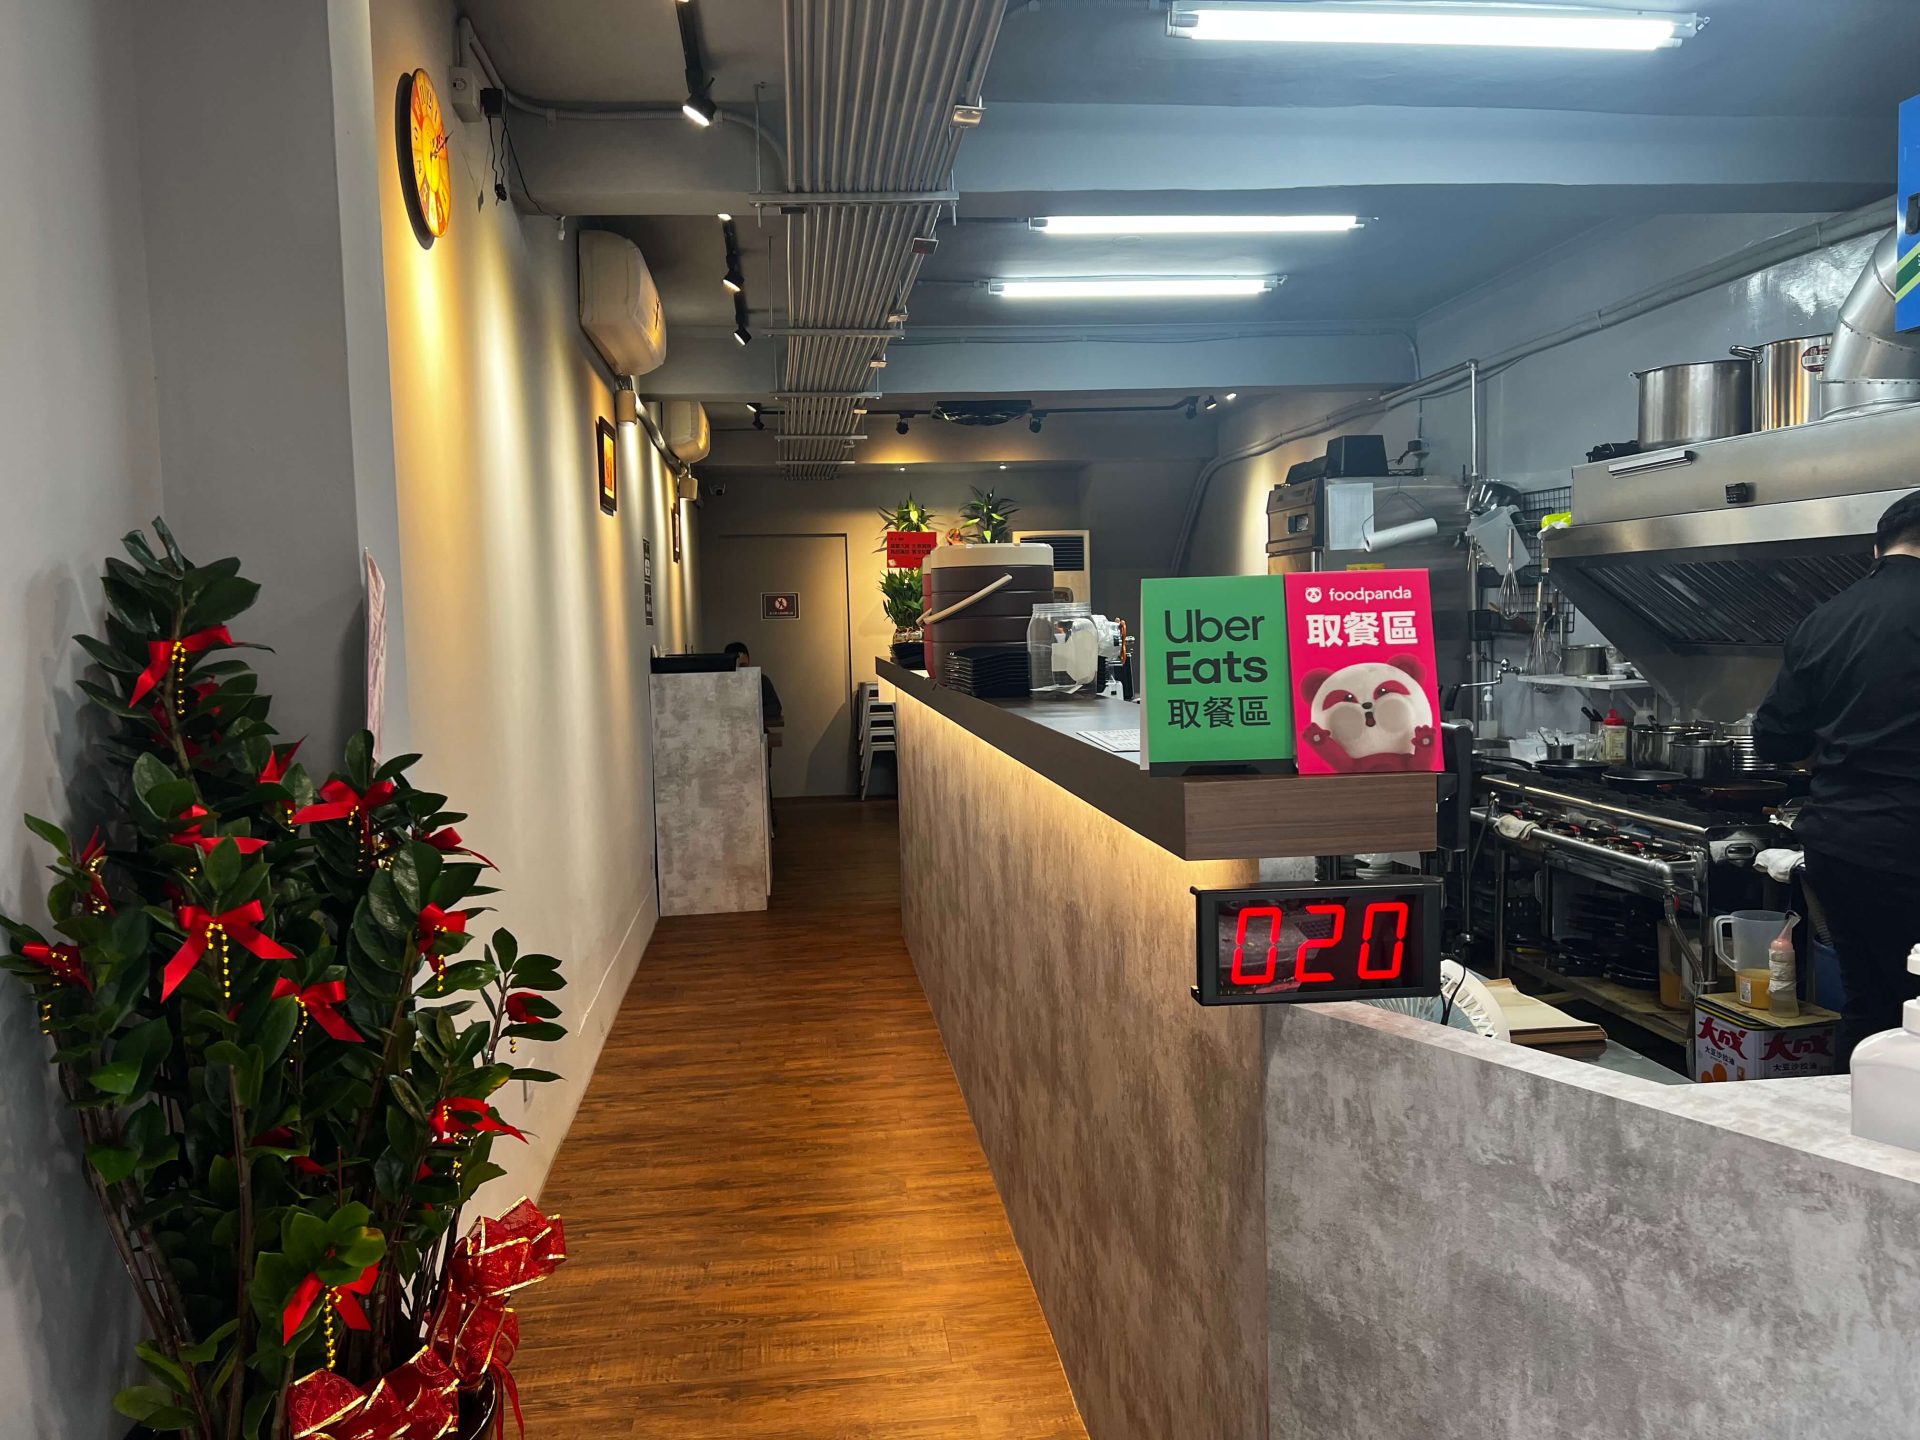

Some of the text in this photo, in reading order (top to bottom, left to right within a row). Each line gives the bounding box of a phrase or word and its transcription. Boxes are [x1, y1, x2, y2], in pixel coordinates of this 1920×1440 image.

[1329, 586, 1412, 604] foodpanda
[1164, 609, 1265, 643] Uber
[1306, 610, 1418, 648] 取餐區
[1166, 650, 1268, 685] Eats
[1168, 695, 1271, 729] 取餐區
[1231, 902, 1409, 985] 020
